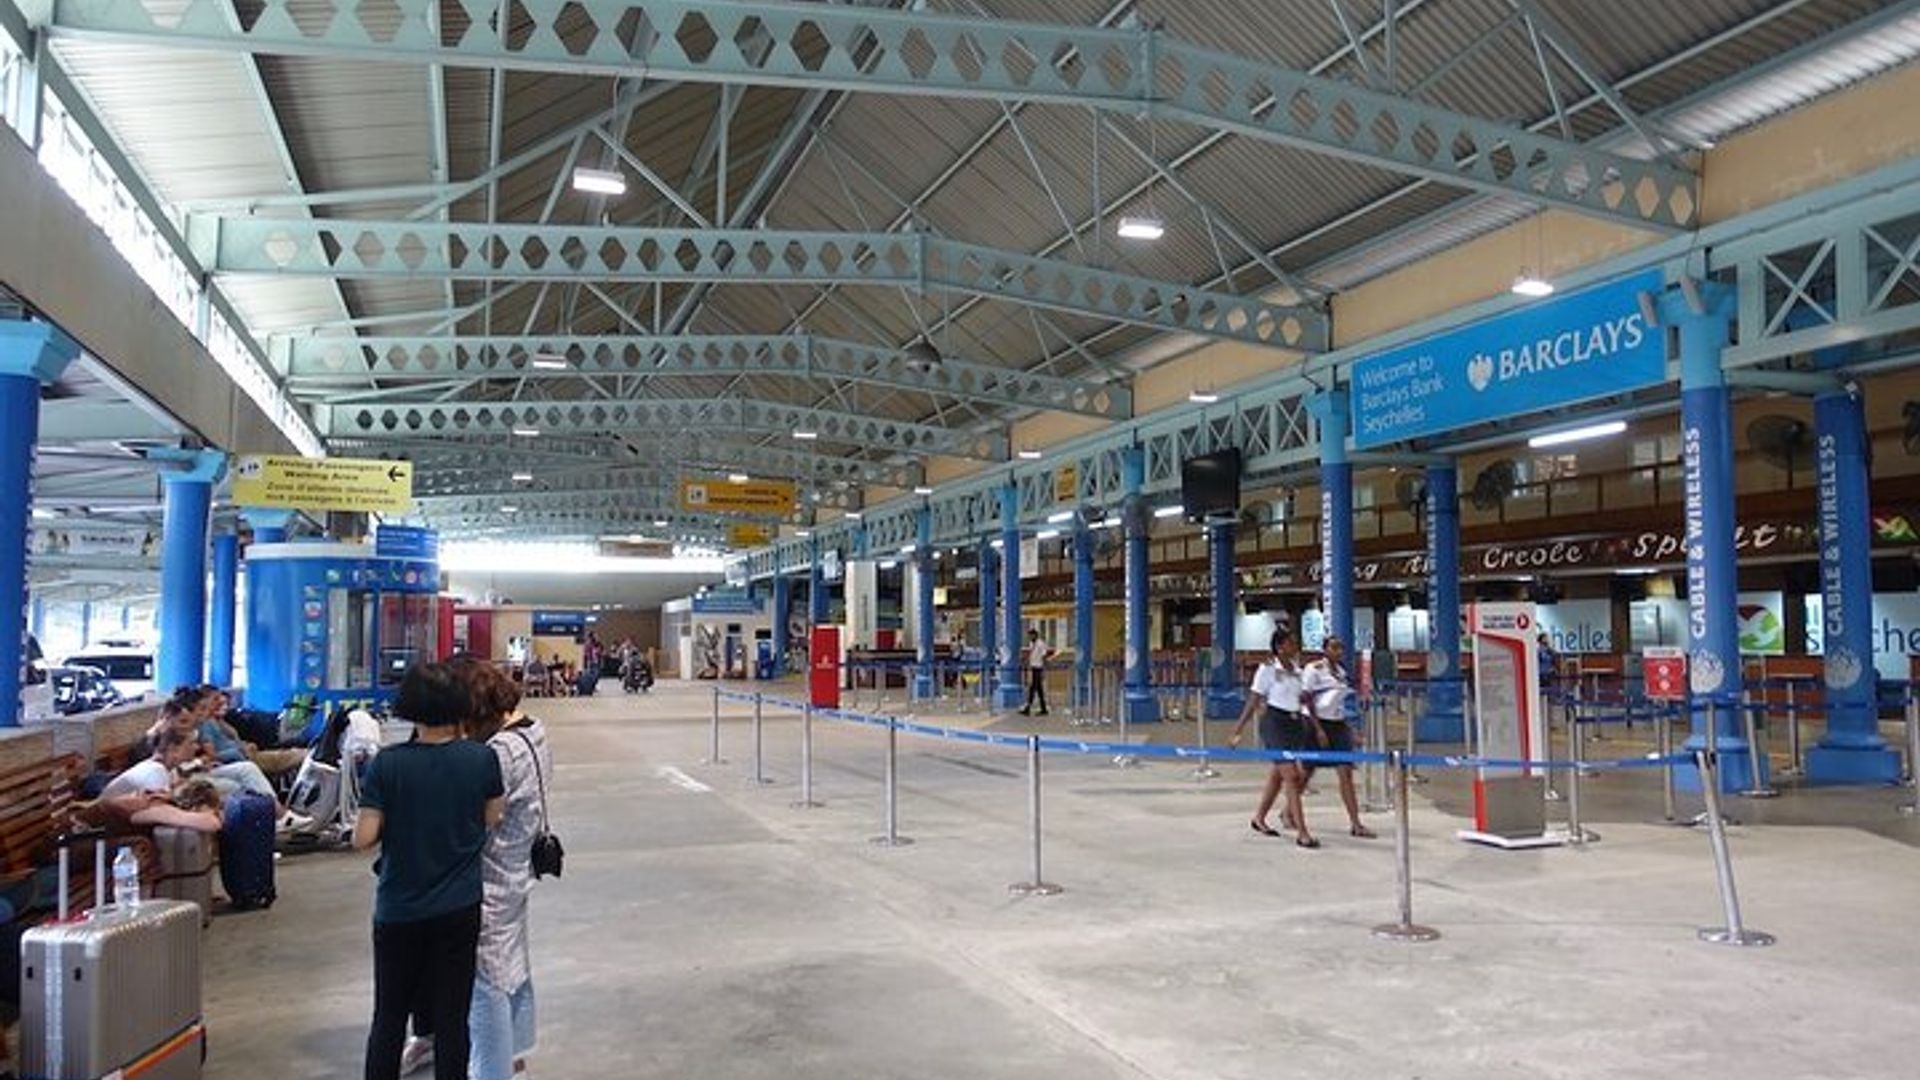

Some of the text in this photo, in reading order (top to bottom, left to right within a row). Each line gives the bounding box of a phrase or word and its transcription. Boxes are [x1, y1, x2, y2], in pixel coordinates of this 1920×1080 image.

[1499, 313, 1643, 381] BARCLAYS
[1360, 355, 1433, 388] Welcome to
[1361, 372, 1445, 411] Barclays Bank
[1363, 405, 1425, 433] Seychelles
[1685, 427, 1706, 639] CABLE & WIRELESS
[1819, 434, 1843, 637] CABLE & WIRELESS
[1483, 543, 1583, 568] Creole
